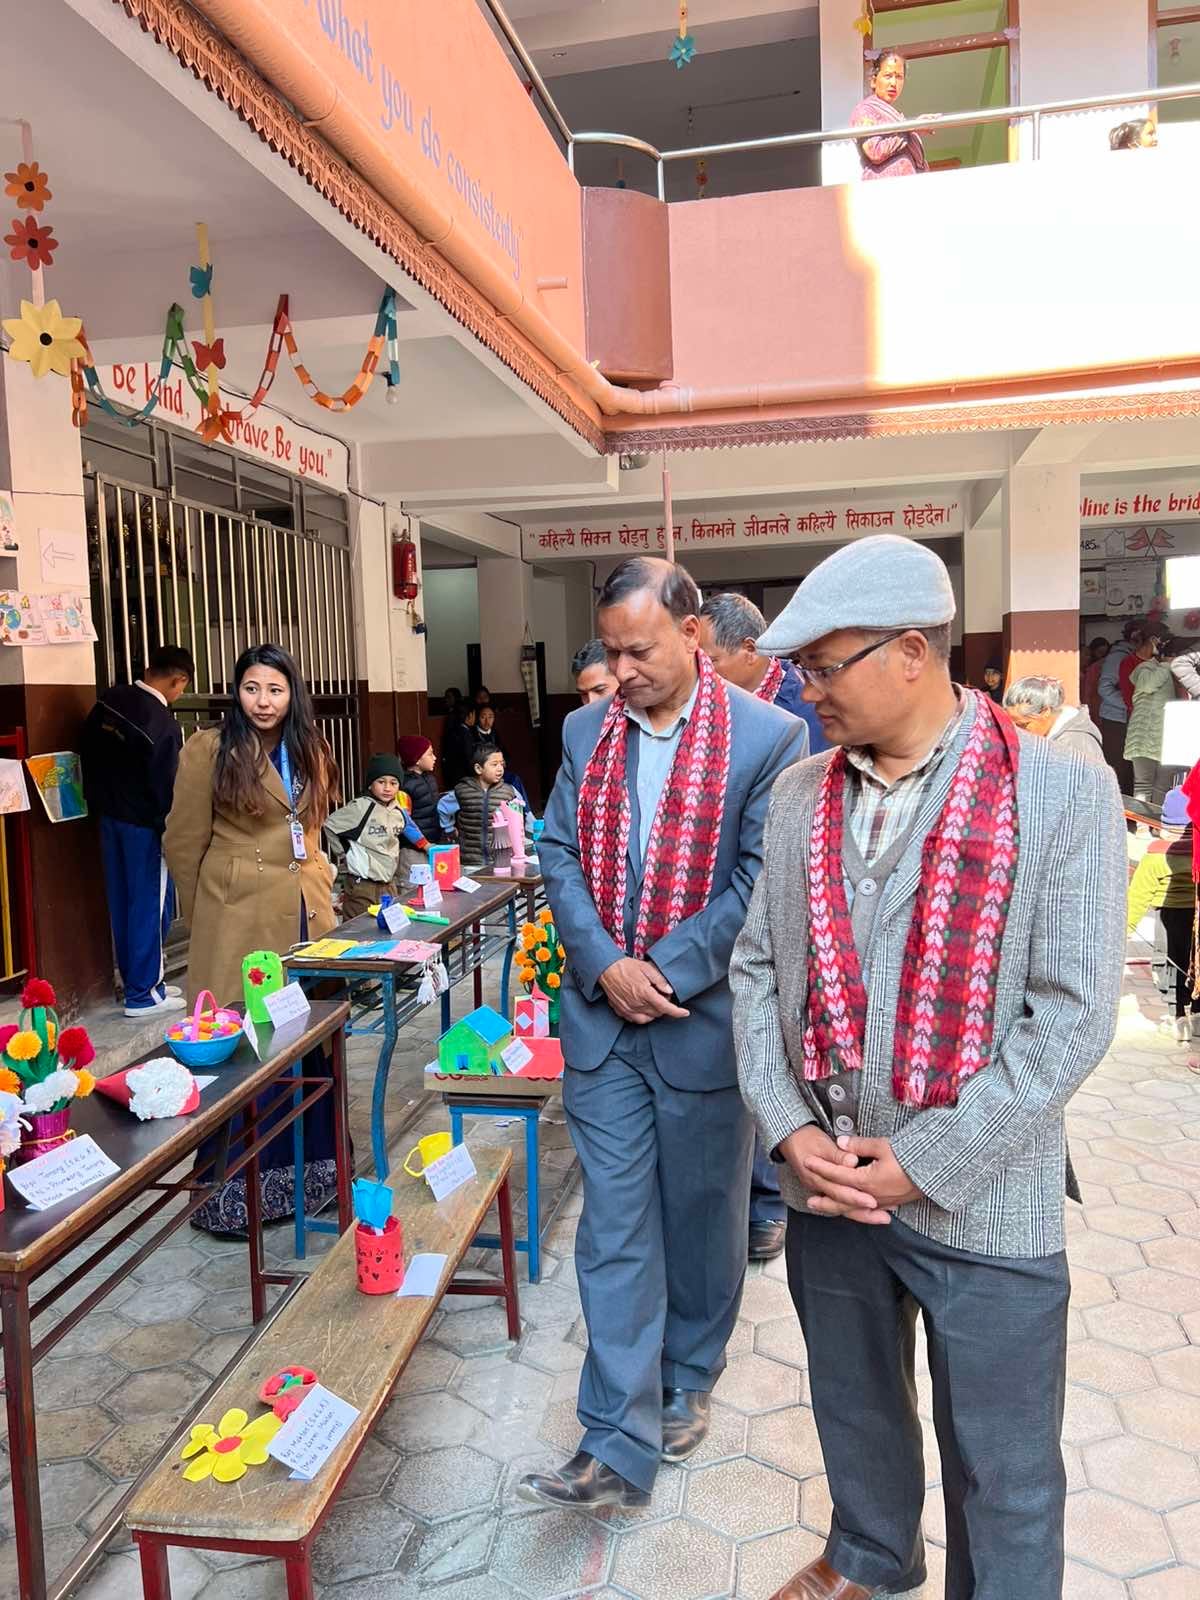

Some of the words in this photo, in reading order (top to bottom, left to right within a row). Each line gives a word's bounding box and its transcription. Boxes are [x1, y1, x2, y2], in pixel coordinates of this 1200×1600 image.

[381, 64, 413, 134] you
[421, 105, 440, 168] do
[1080, 497, 1109, 516] line
[1114, 497, 1128, 515] is
[1133, 494, 1161, 514] the
[743, 513, 790, 536] जीवनले
[845, 509, 895, 530] सिकाउन
